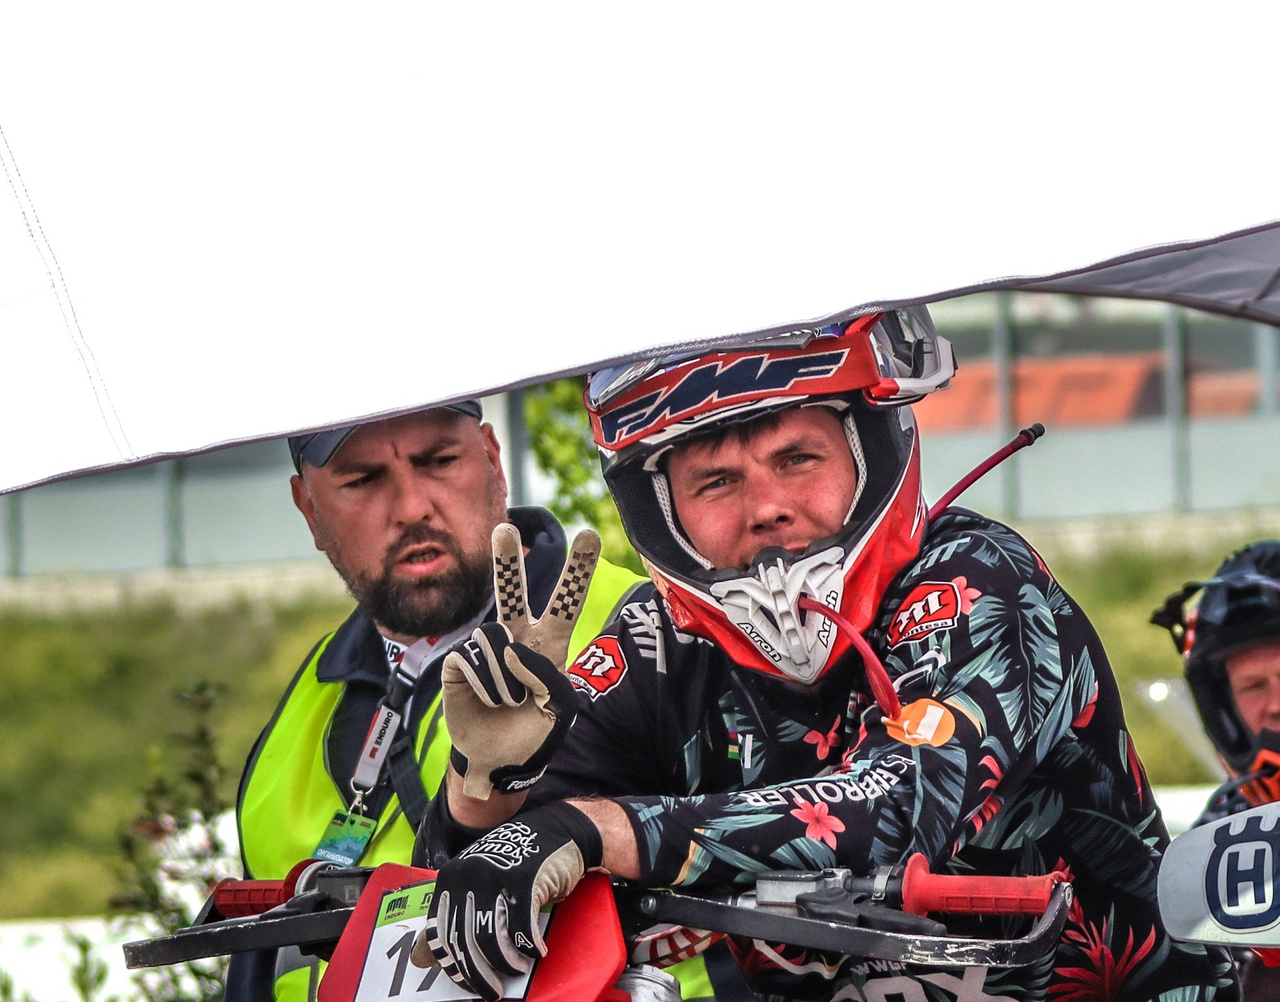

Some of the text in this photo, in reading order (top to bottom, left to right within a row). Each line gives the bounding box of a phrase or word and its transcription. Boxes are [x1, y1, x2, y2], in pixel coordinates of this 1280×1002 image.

[598, 347, 852, 446] FMF
[902, 619, 949, 639] ontesa
[374, 711, 394, 746] ENDURO
